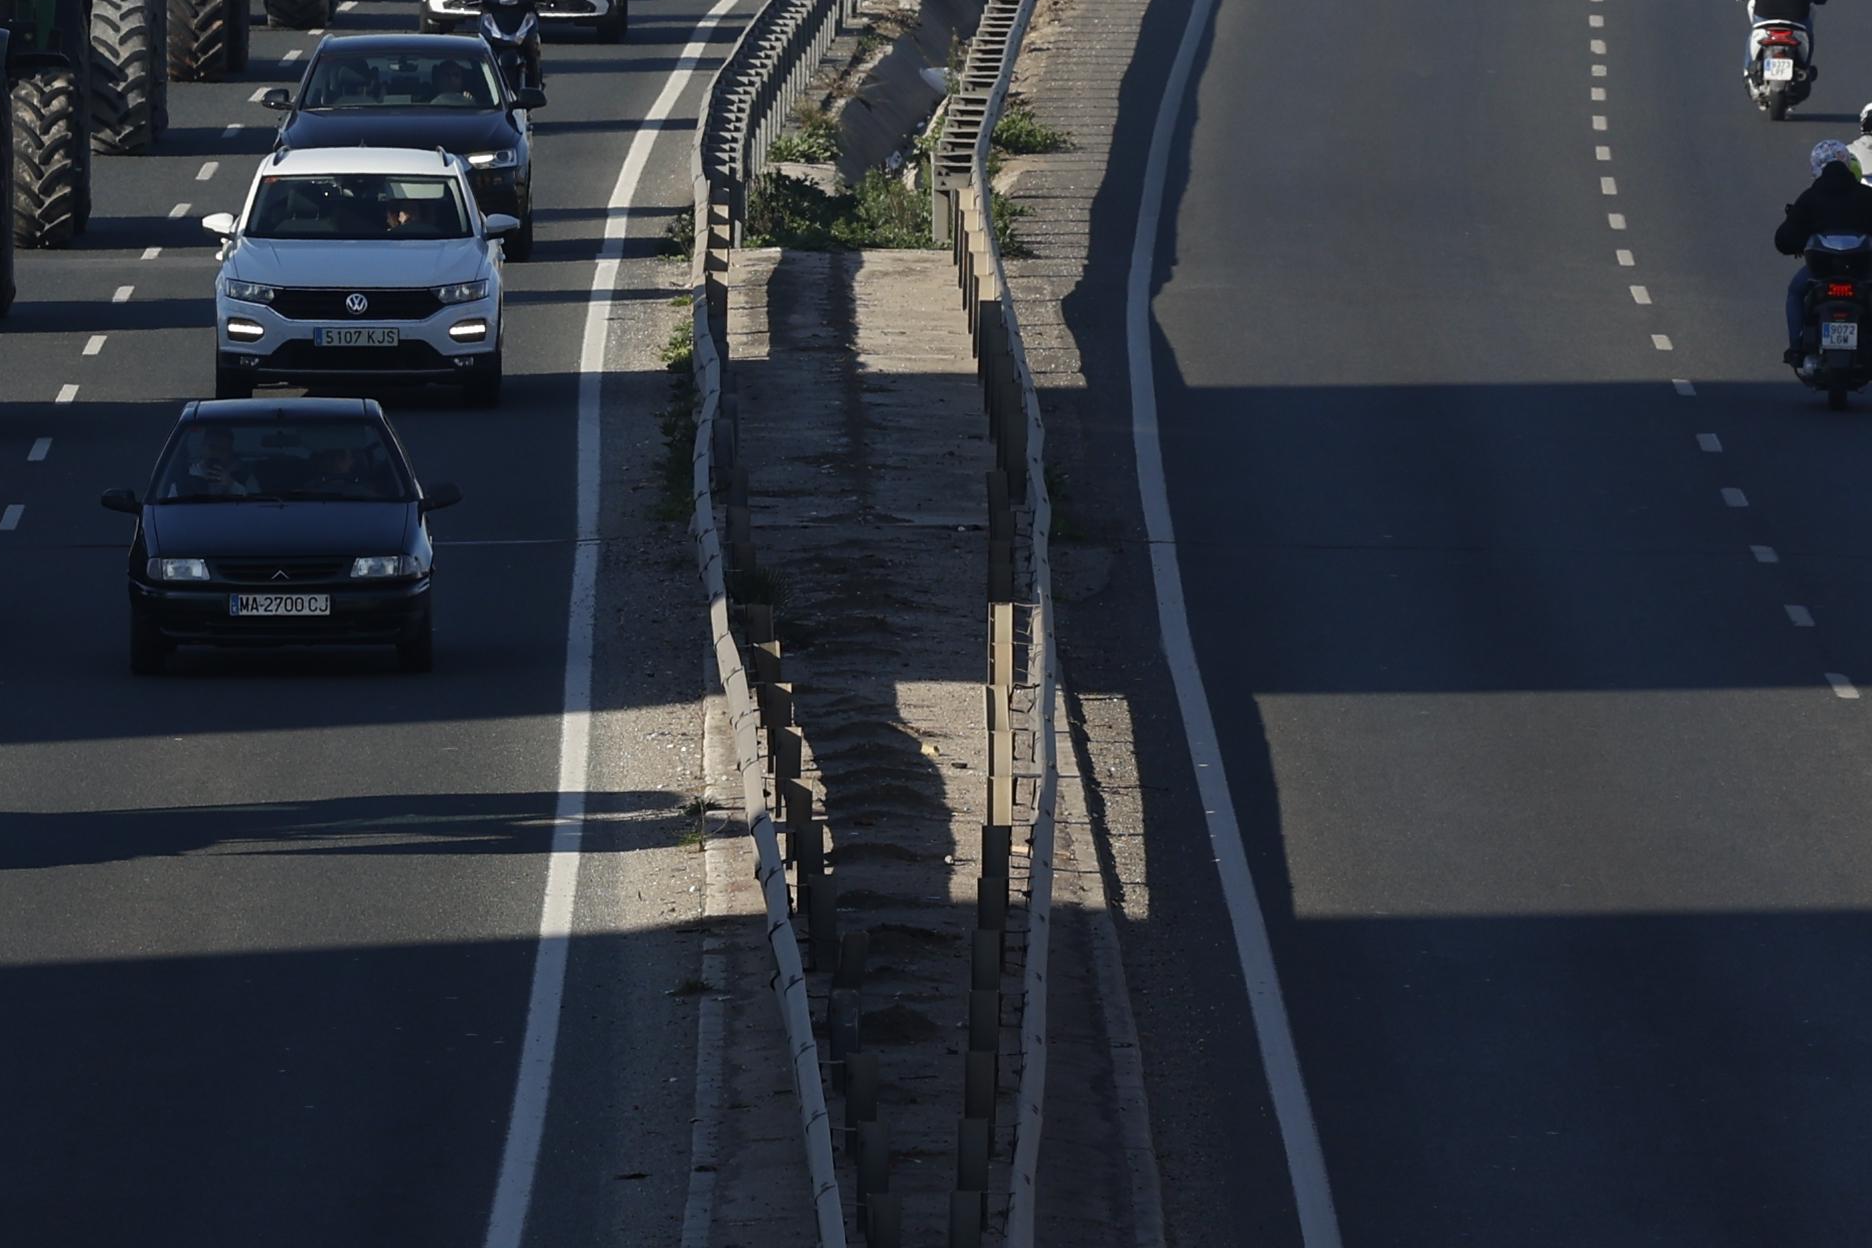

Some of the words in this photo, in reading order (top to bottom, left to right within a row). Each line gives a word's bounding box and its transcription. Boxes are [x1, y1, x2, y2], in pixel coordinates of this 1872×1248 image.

[325, 330, 362, 345] 5107
[367, 330, 396, 345] KJS
[239, 596, 305, 613] MA-2700
[308, 596, 329, 613] CJ
